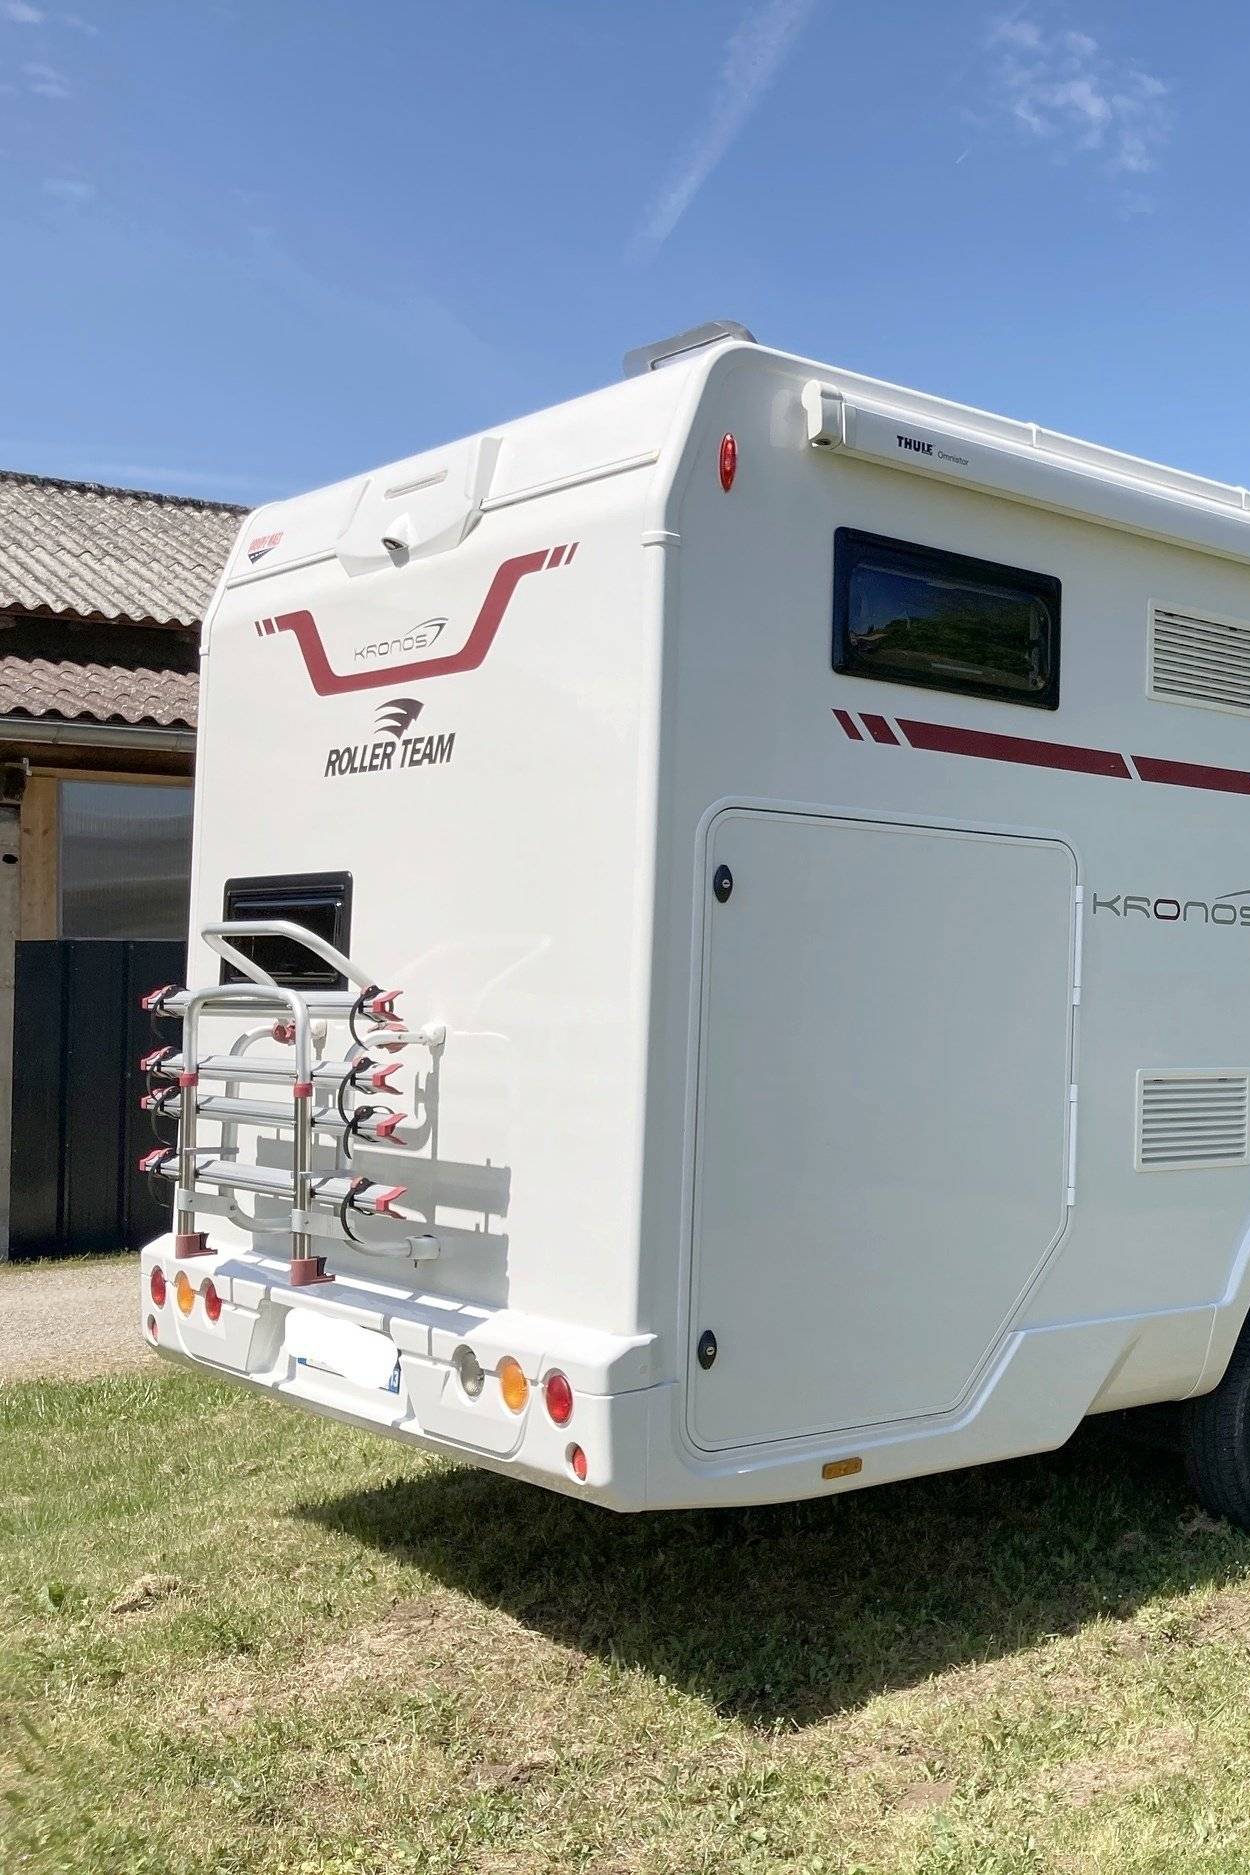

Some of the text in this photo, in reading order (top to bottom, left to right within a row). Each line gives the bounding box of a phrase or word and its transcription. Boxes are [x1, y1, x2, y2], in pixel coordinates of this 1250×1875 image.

[897, 435, 933, 453] THULE
[353, 634, 427, 660] KRONOS
[324, 732, 456, 777] ROLLER TEAM
